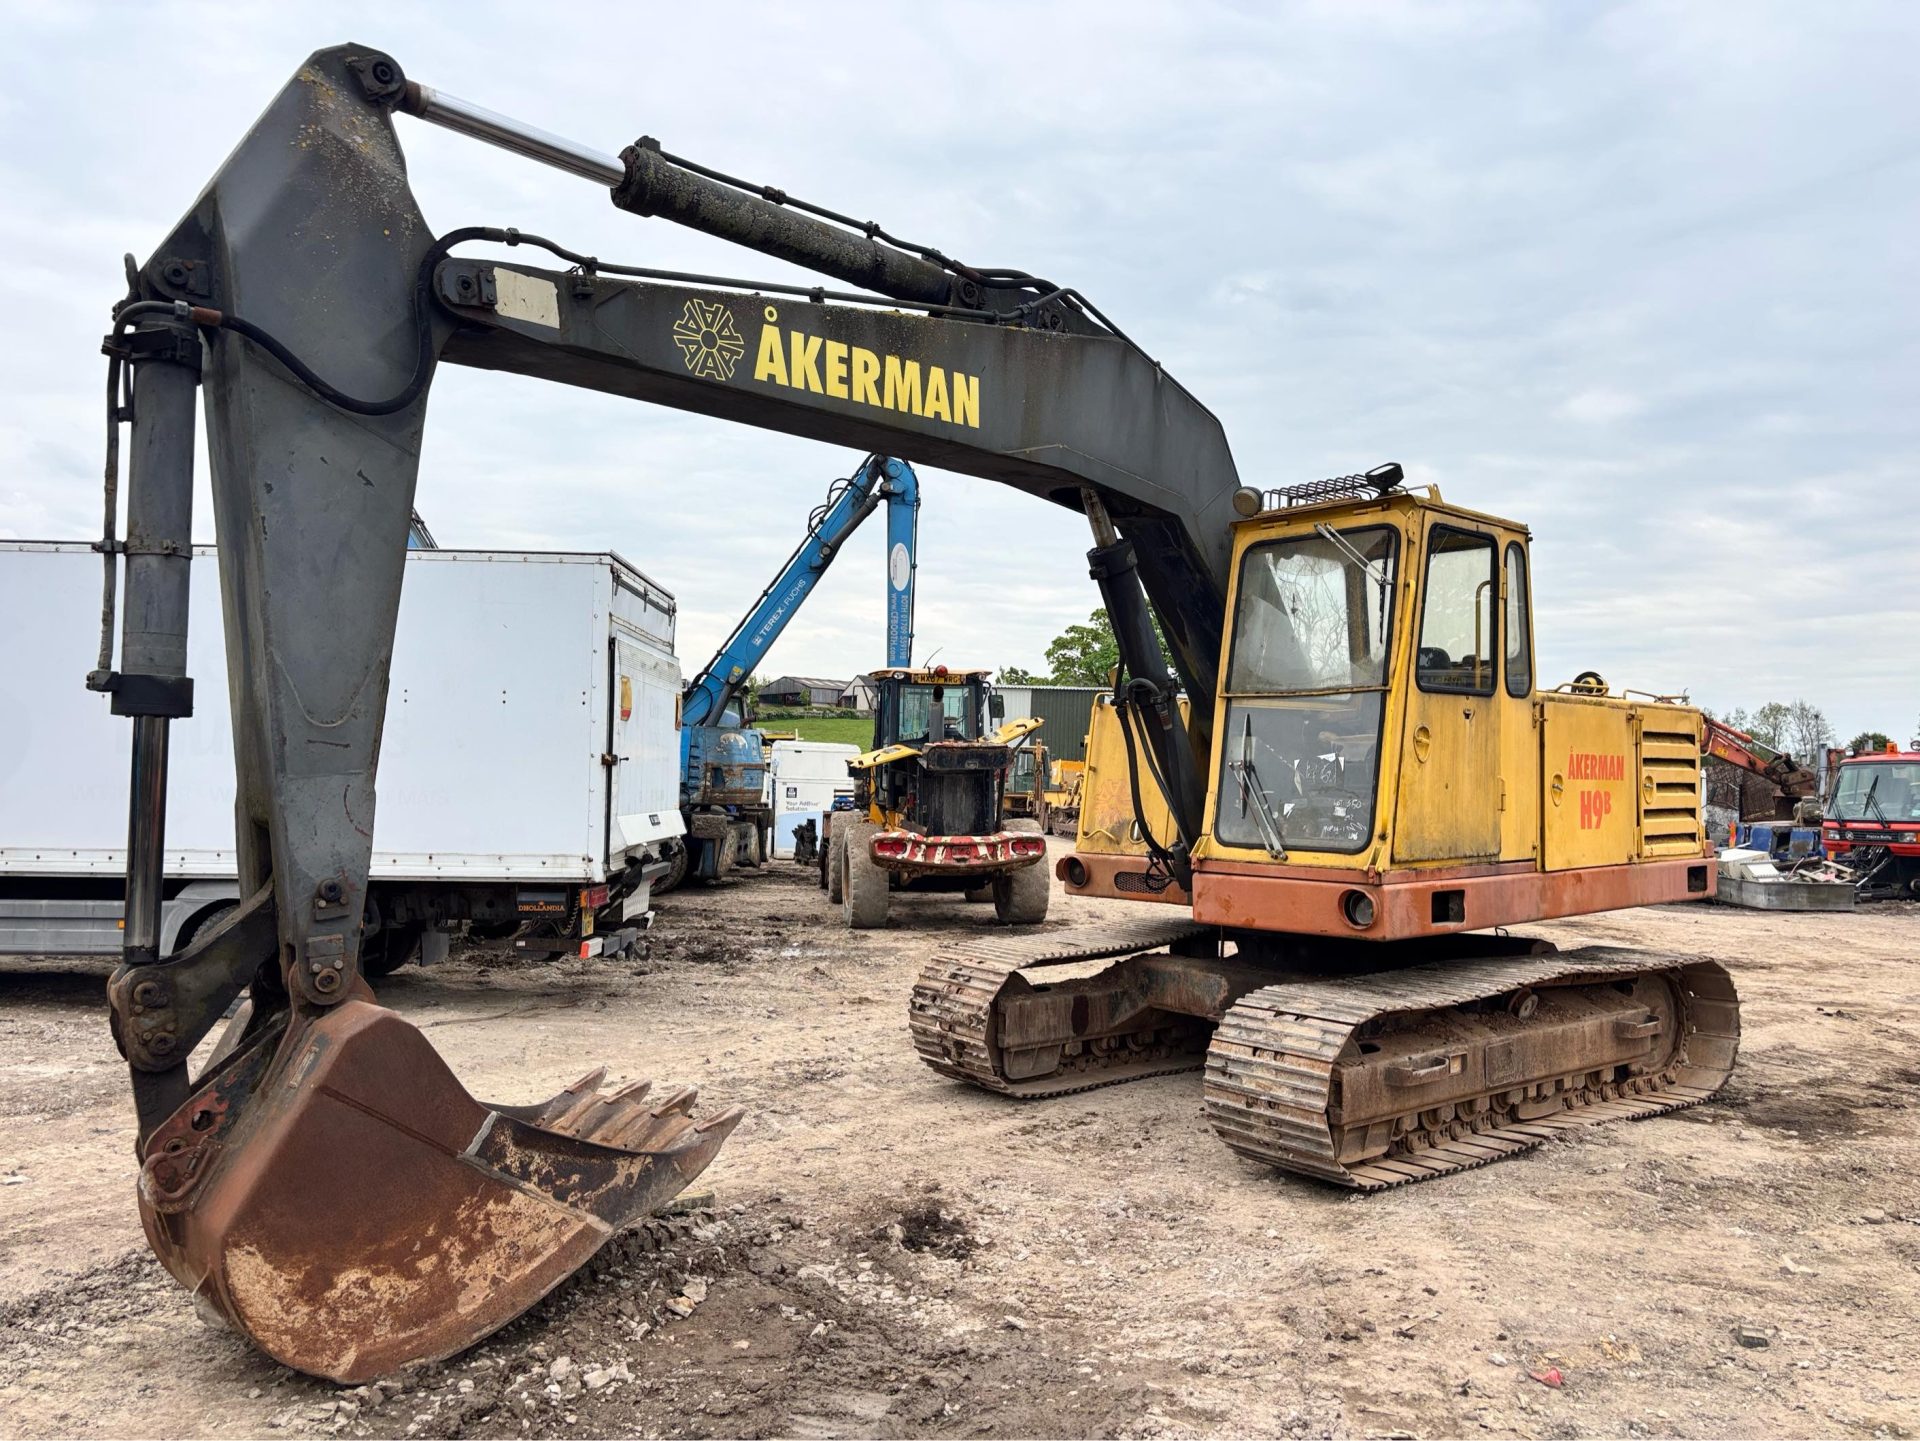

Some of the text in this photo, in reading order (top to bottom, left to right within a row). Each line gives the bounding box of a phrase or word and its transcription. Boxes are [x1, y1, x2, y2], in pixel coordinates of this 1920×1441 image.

[754, 306, 980, 429] ÅKERMAN
[760, 579, 806, 636] TEREX FUCHS
[518, 904, 566, 912] DHOLLANDIA
